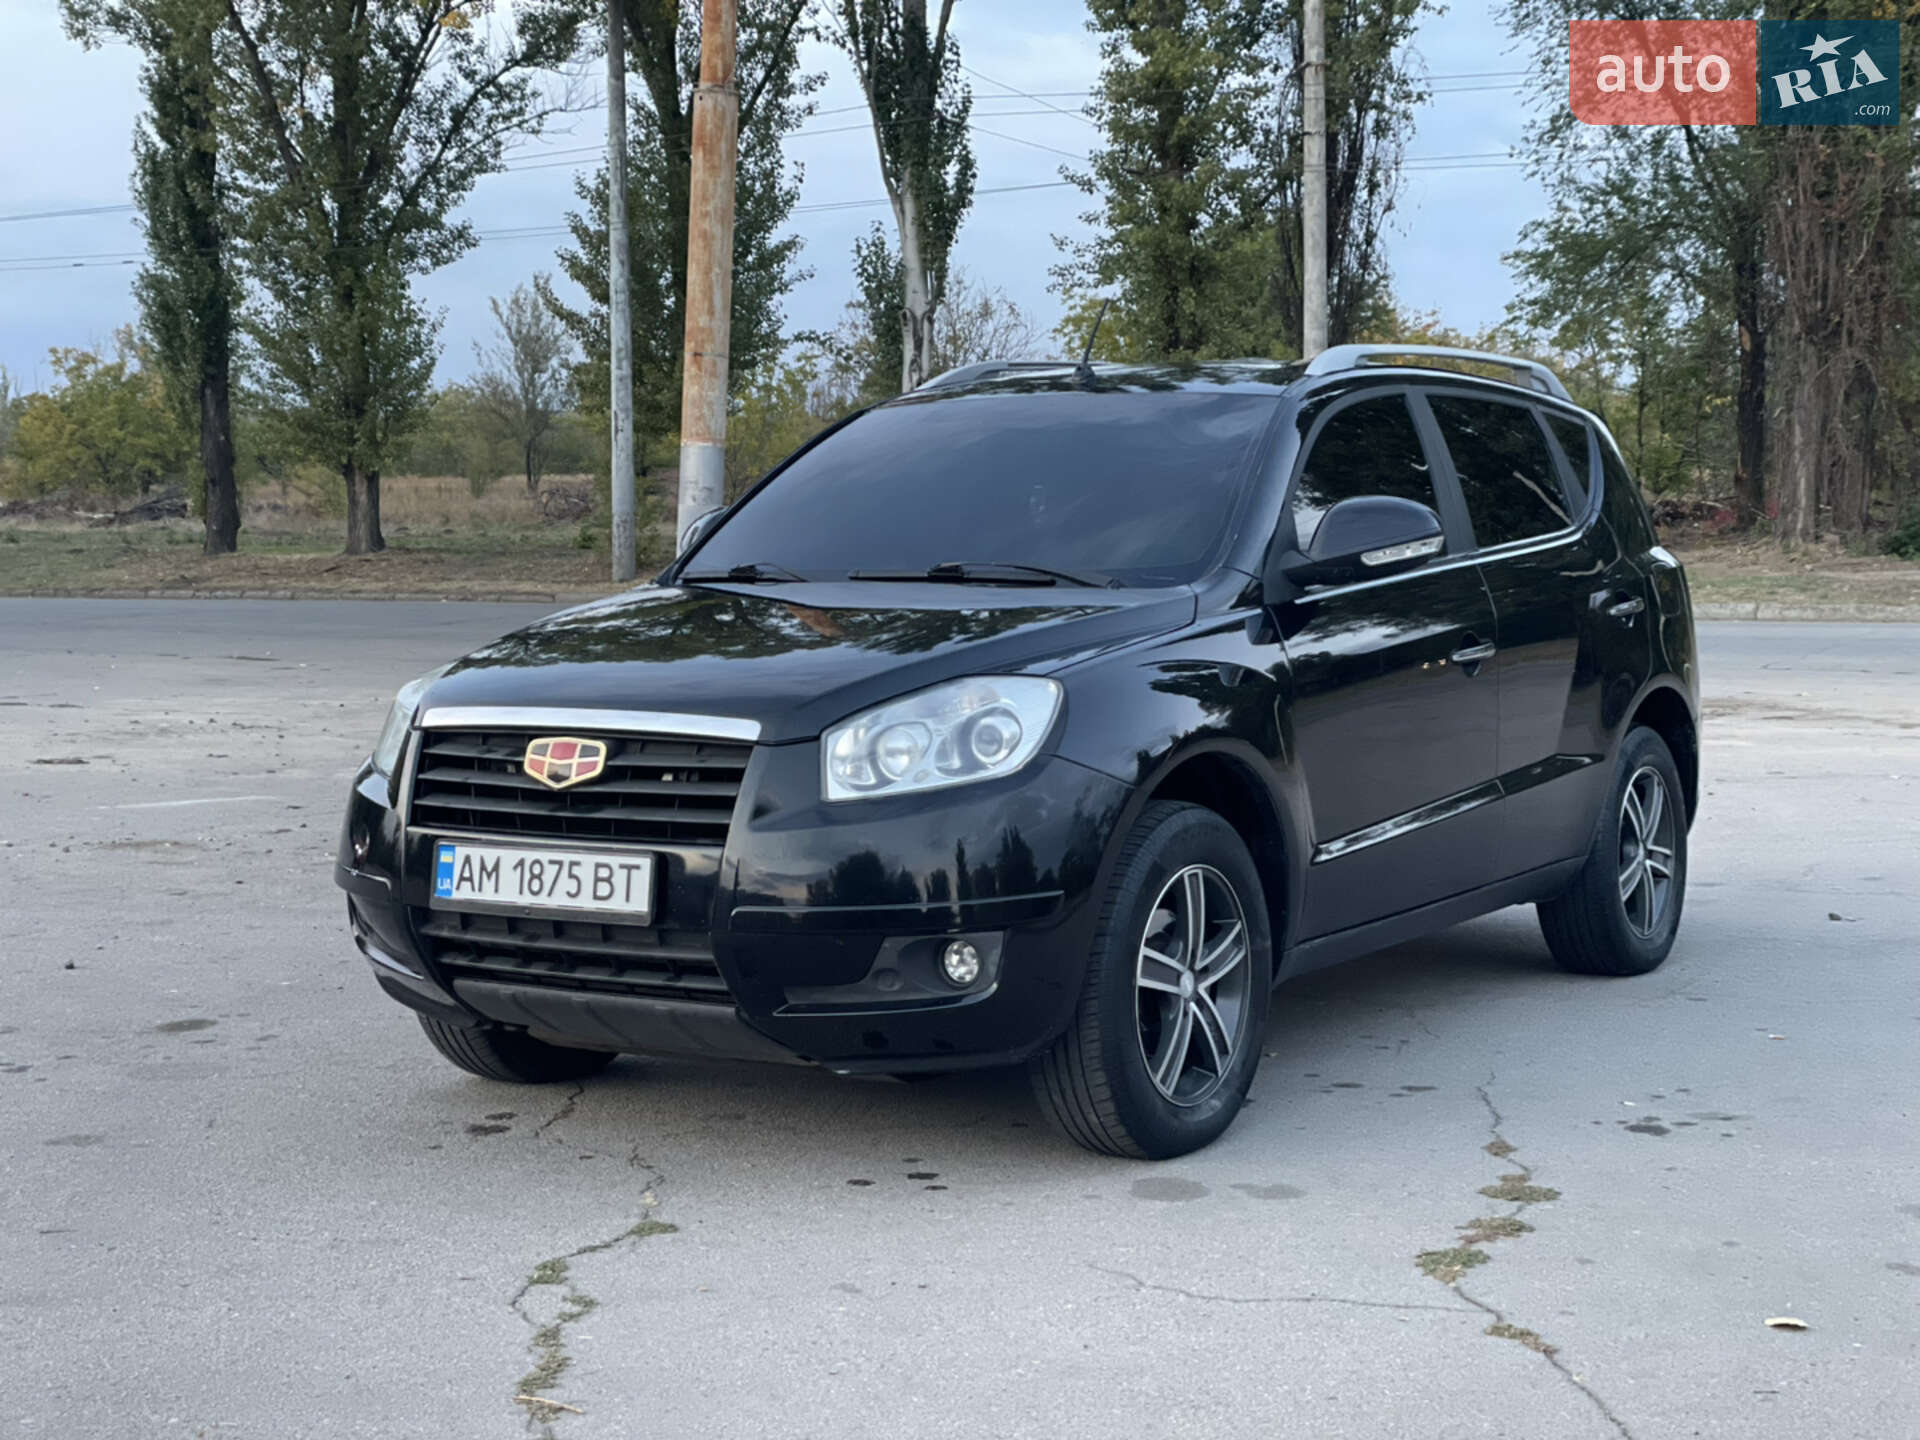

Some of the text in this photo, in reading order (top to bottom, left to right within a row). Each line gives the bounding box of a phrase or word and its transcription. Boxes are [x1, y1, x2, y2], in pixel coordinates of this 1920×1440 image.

[437, 877, 452, 889] UA
[455, 853, 641, 903] AM 1875 BT
